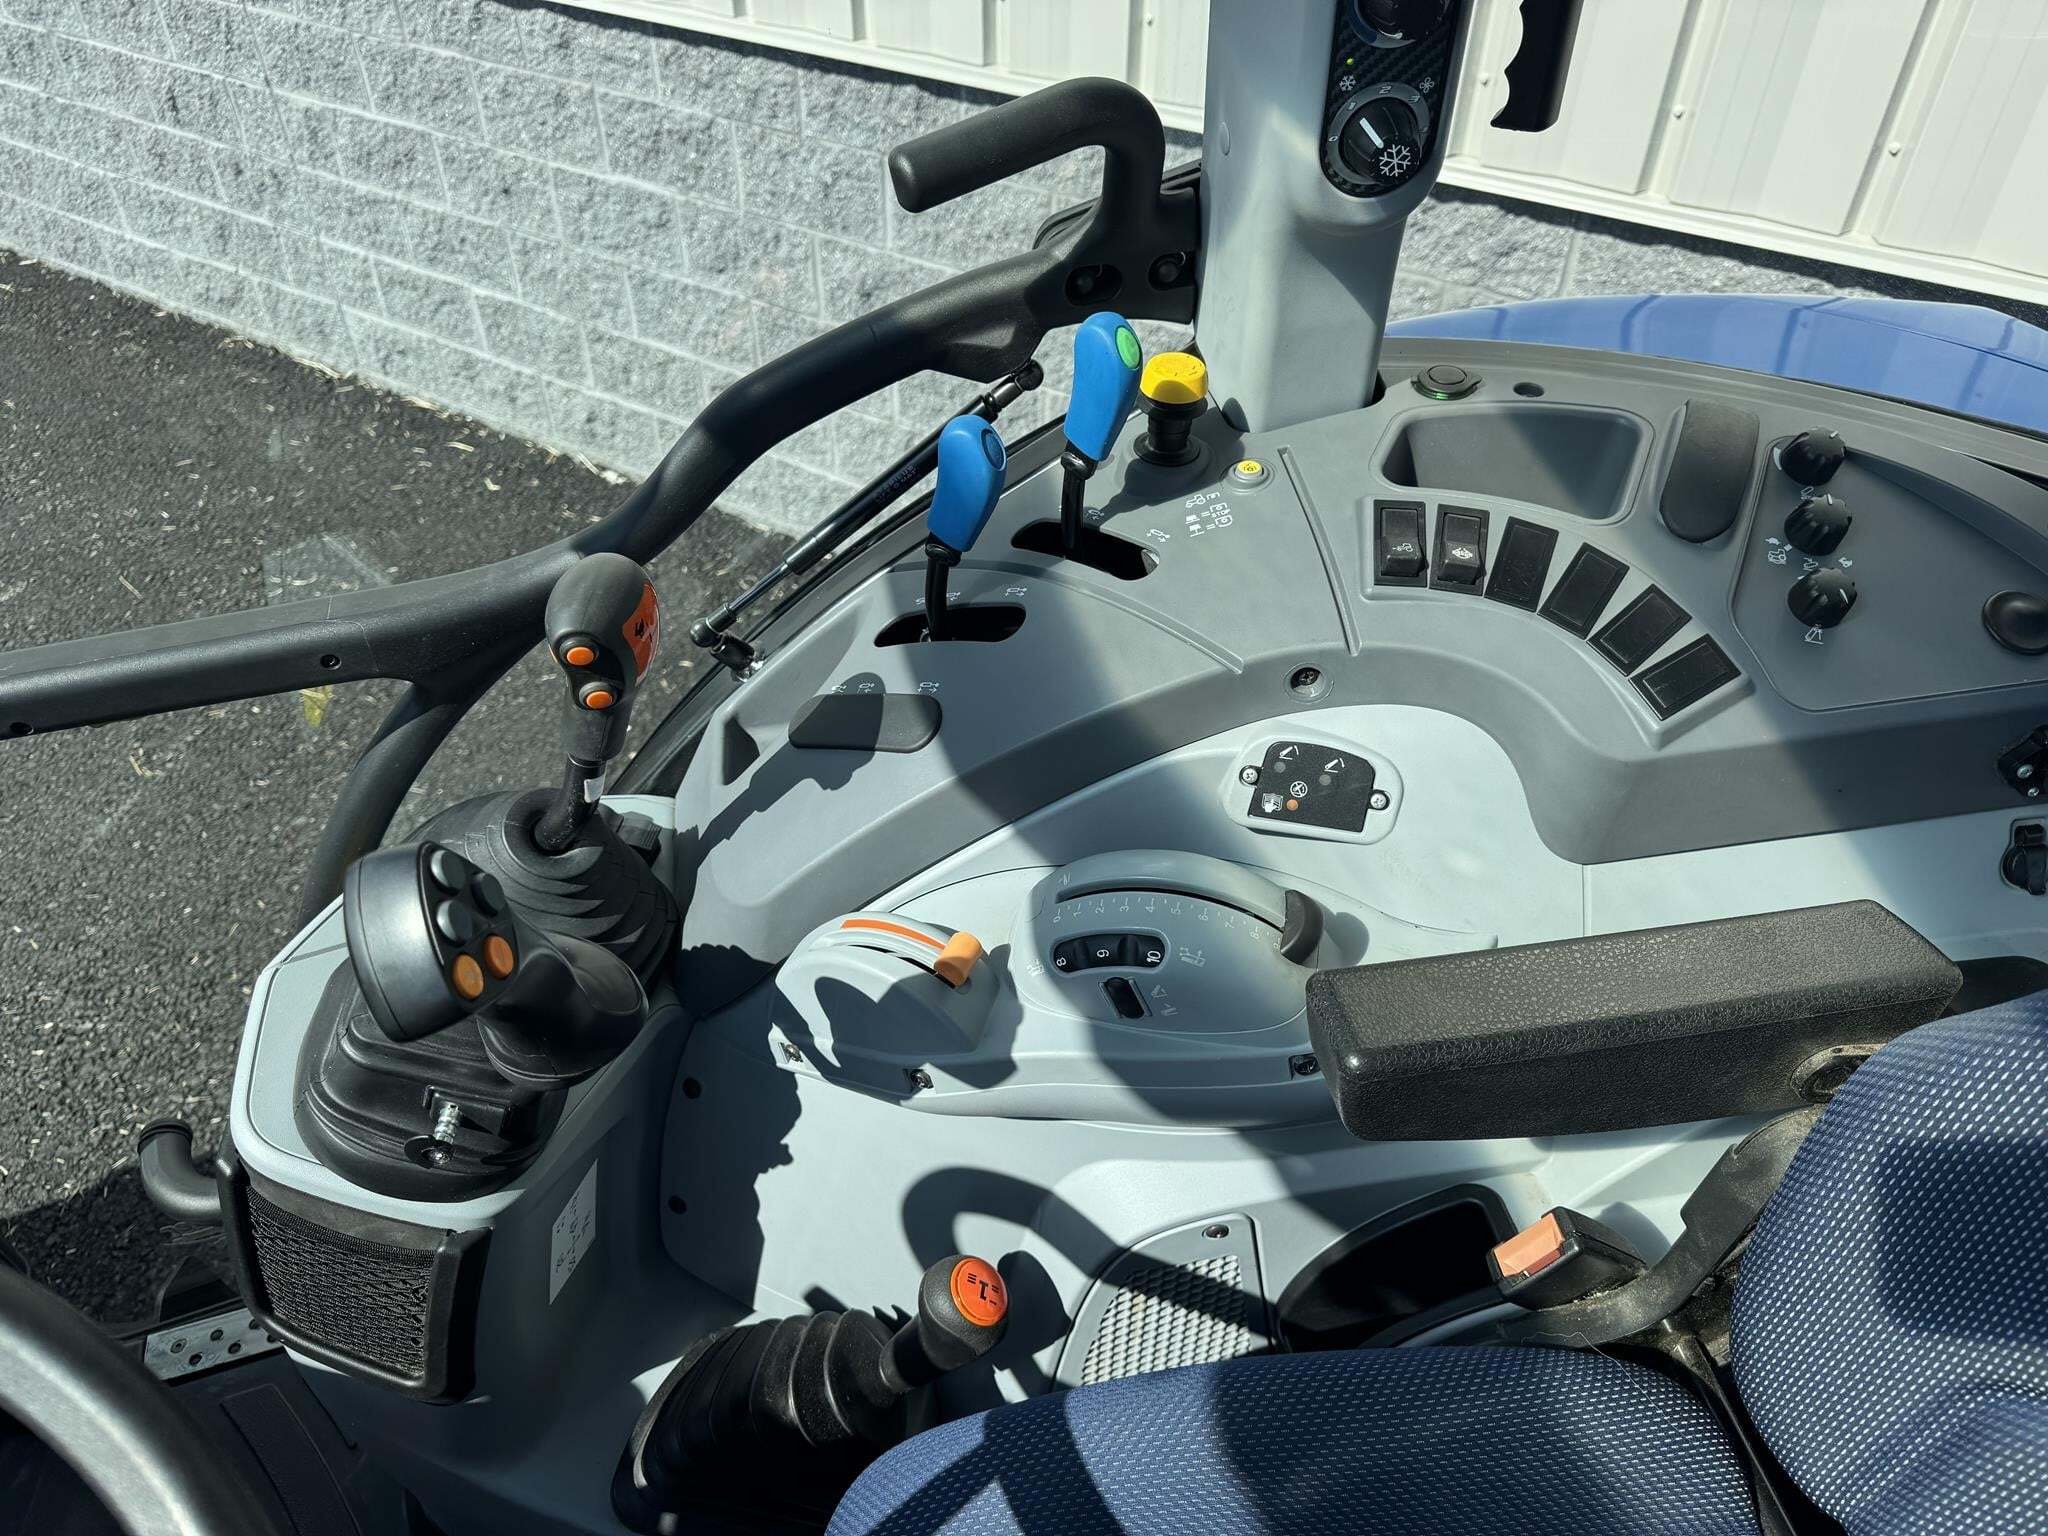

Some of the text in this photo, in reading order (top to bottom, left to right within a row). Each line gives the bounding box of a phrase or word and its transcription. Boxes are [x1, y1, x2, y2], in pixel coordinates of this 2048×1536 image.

[1380, 85, 1392, 94] 2
[1096, 949, 1110, 958] 9
[1146, 950, 1161, 963] 10
[1056, 957, 1067, 967] 8
